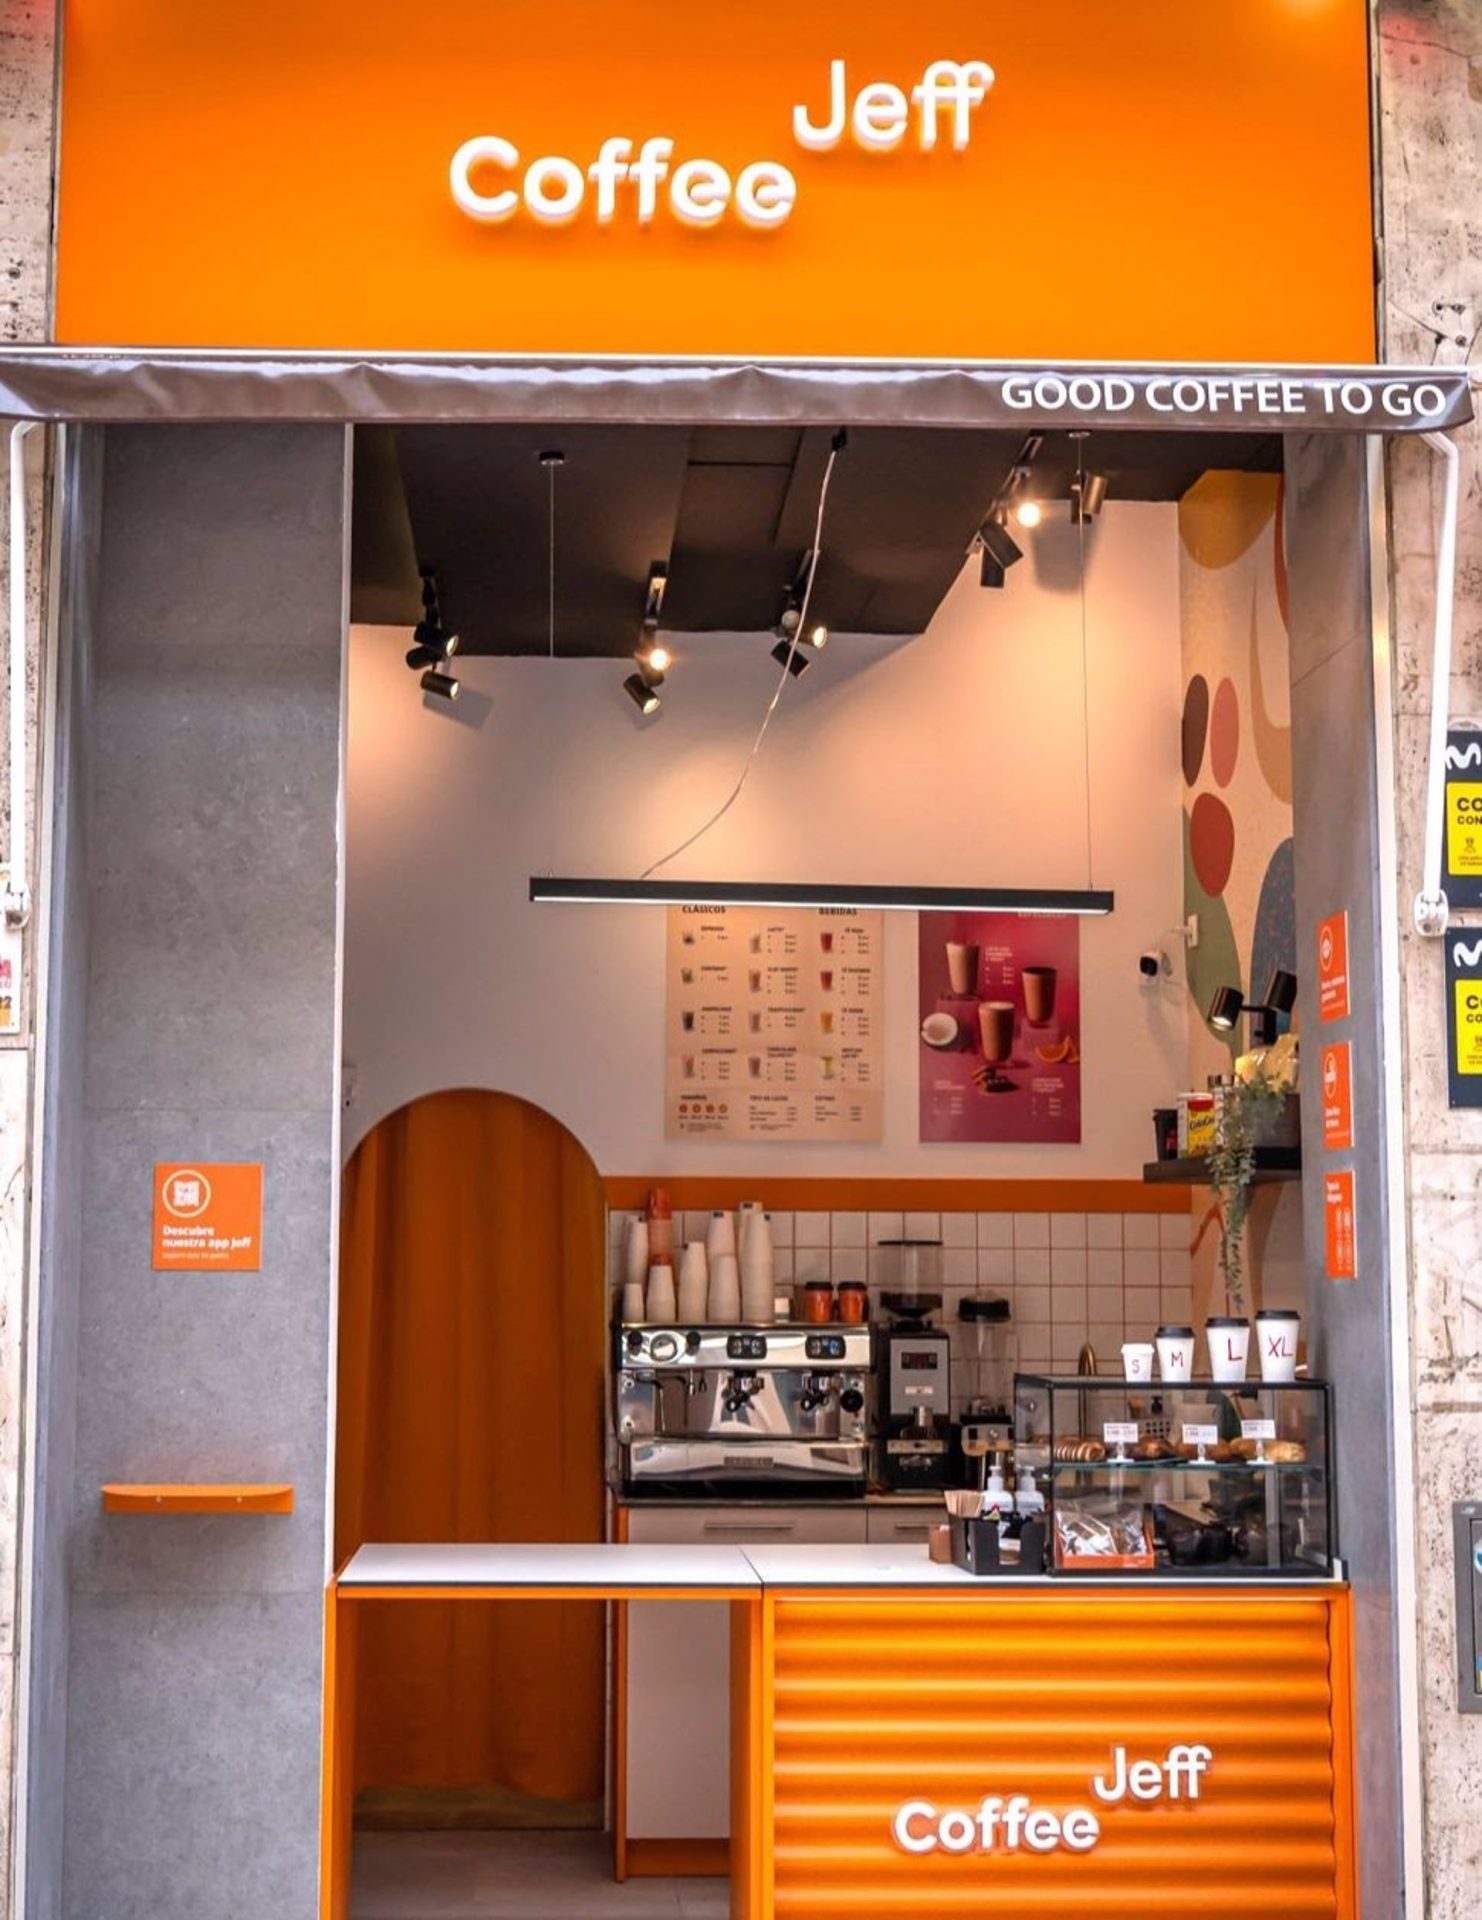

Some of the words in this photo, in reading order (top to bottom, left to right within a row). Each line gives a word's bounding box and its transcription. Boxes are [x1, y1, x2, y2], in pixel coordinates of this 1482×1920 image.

[793, 60, 994, 152] Jeff
[449, 136, 796, 229] Coffee
[1001, 377, 1134, 411] GOOD
[1145, 379, 1306, 414] COFFEE
[1310, 382, 1373, 415] TO
[1382, 384, 1446, 417] GO
[1131, 1358, 1141, 1374] S
[1171, 1351, 1184, 1367] M
[1227, 1338, 1243, 1361] L
[1268, 1336, 1293, 1358] XL
[1093, 1745, 1212, 1801] Jeff
[894, 1797, 1099, 1850] Coffee
